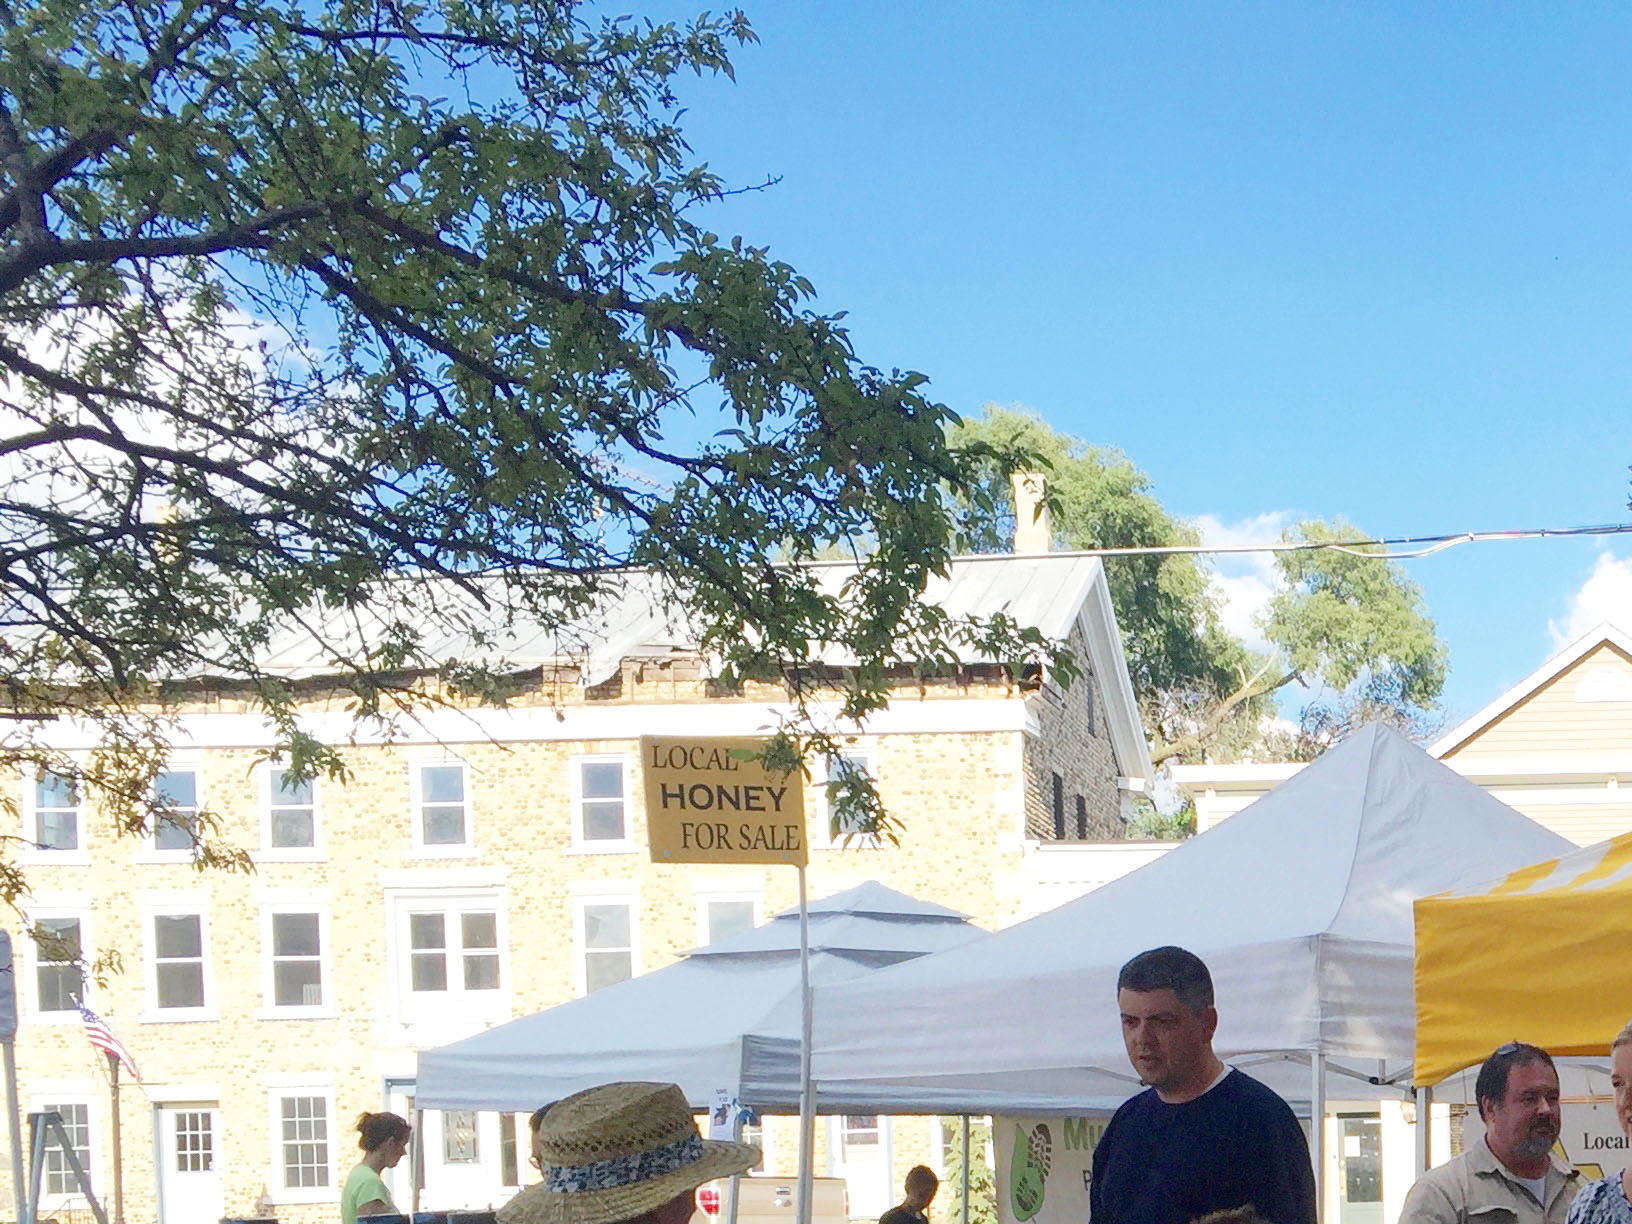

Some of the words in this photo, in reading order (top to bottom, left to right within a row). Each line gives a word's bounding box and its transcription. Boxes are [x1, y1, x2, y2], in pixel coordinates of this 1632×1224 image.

[651, 745, 738, 771] LOCAL
[661, 783, 787, 812] HONEY
[680, 822, 734, 850] FOR
[739, 823, 800, 851] SALE
